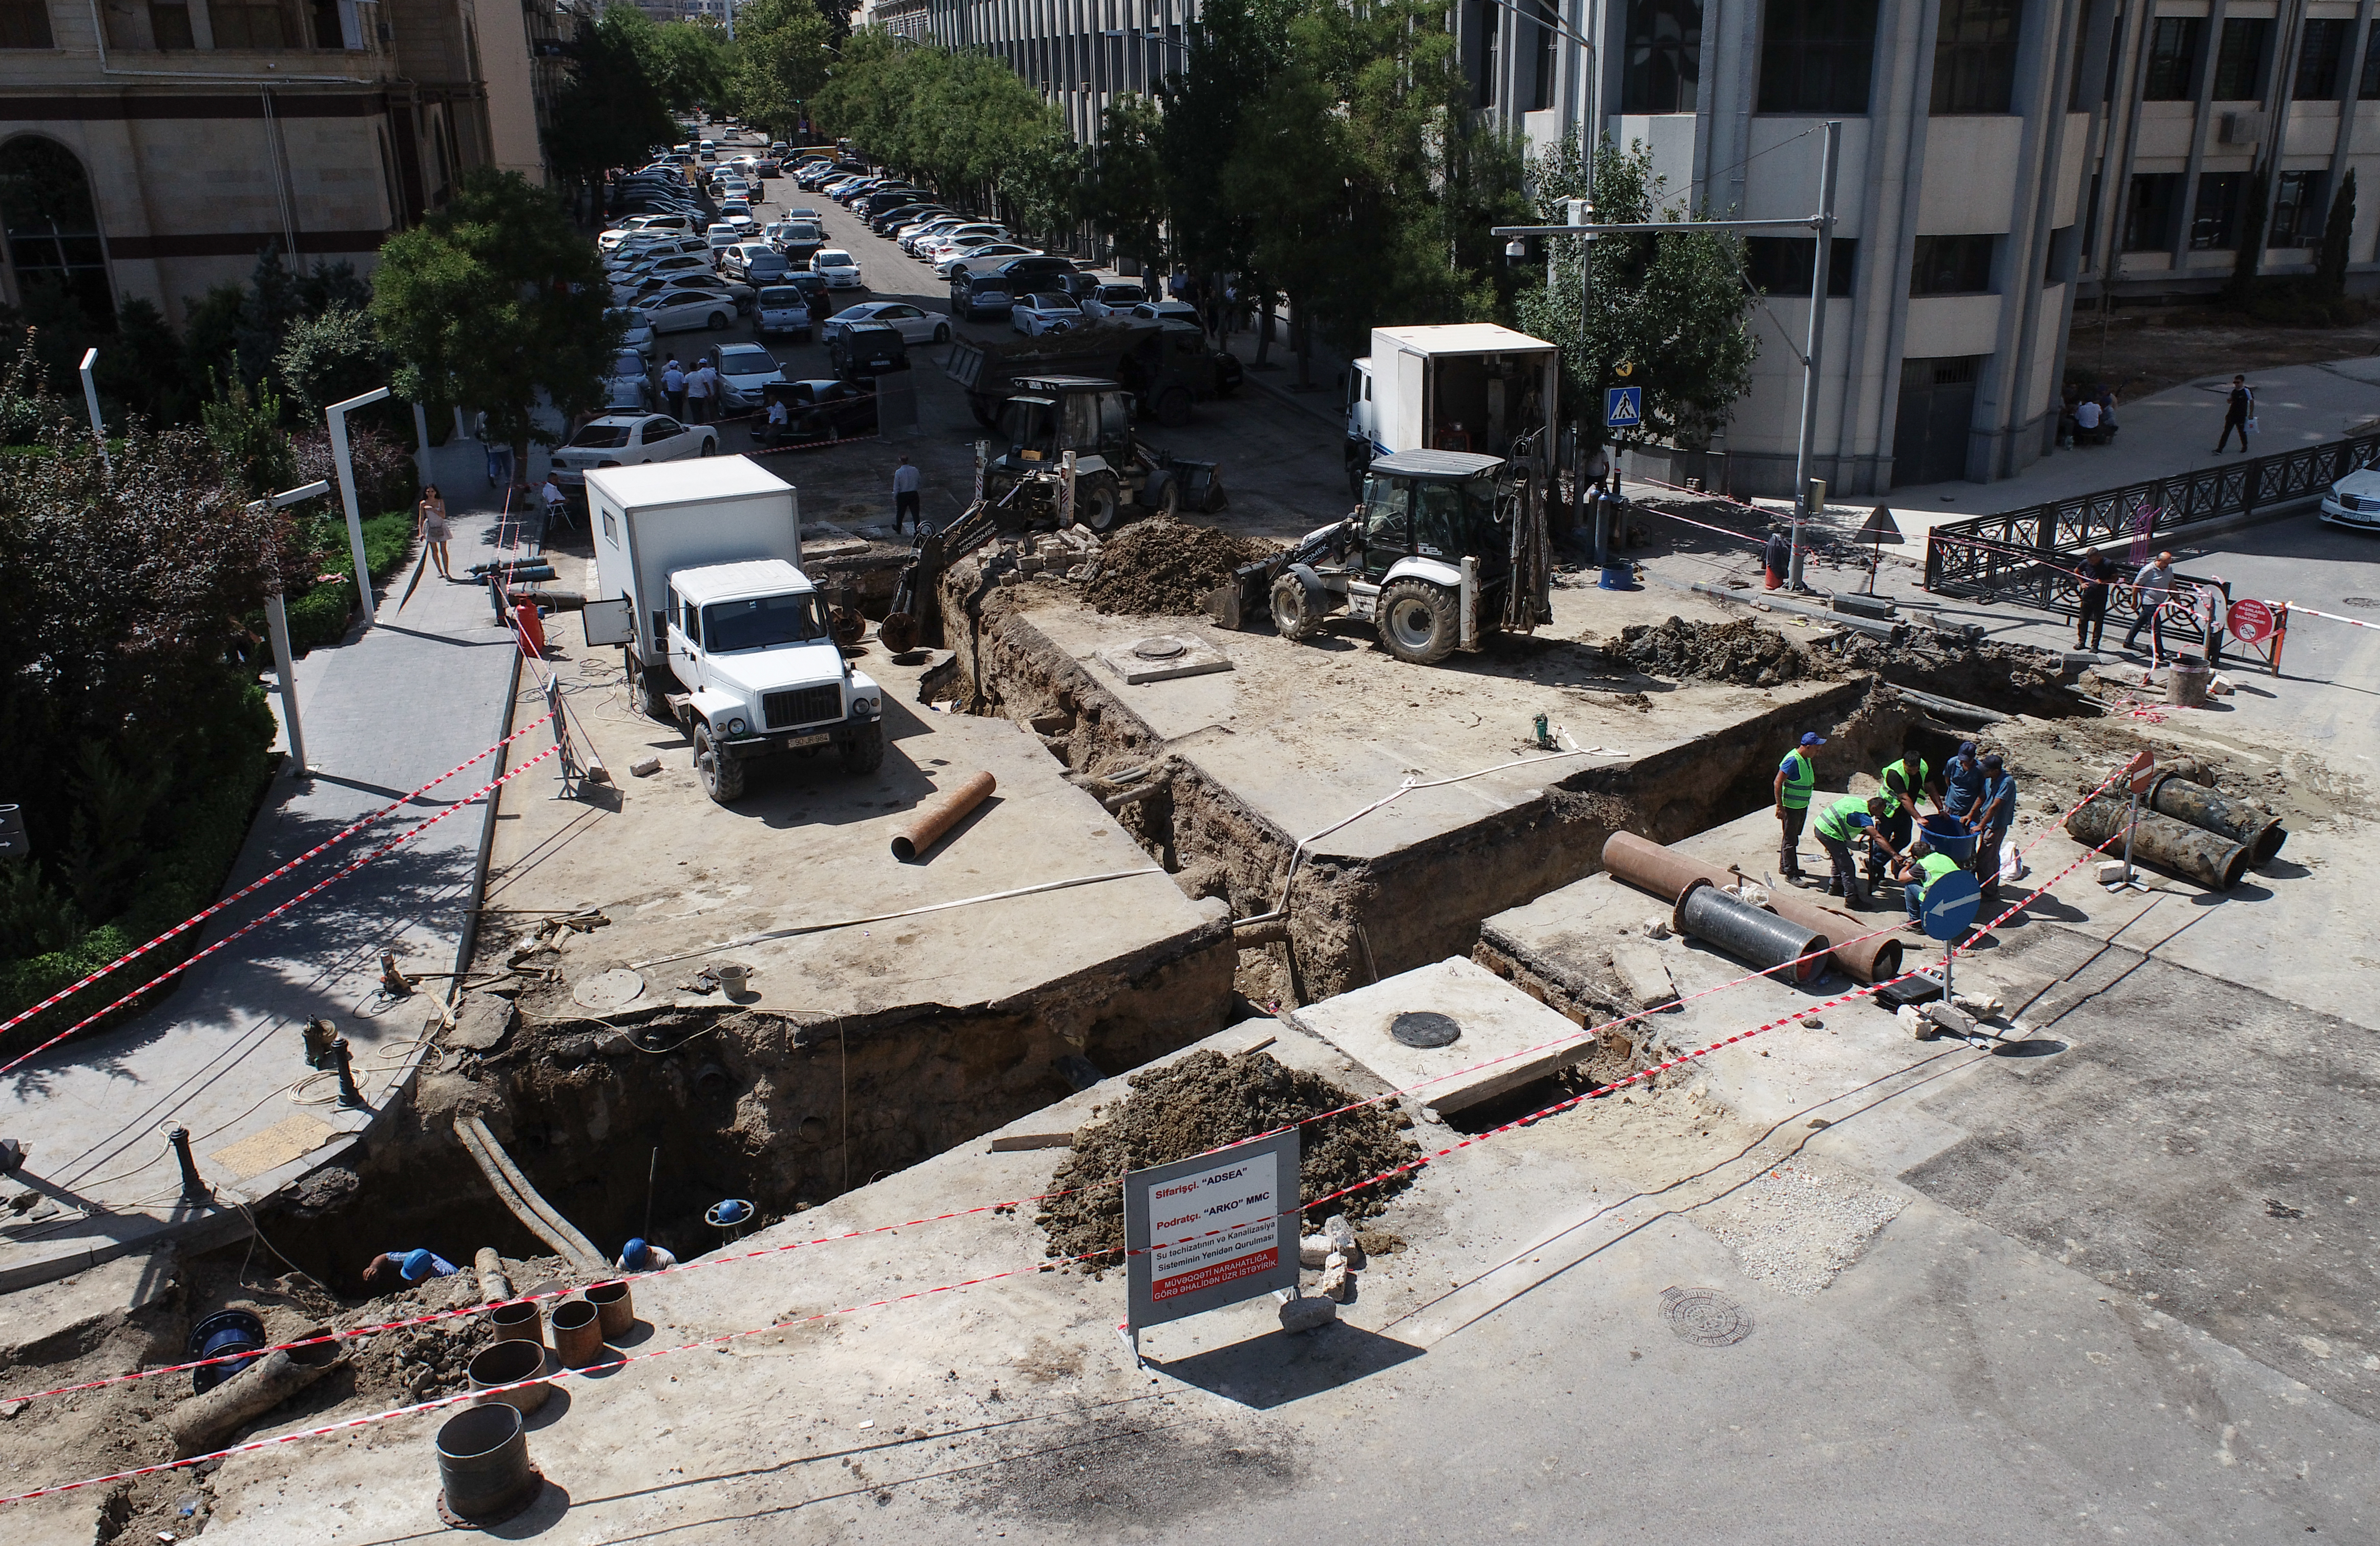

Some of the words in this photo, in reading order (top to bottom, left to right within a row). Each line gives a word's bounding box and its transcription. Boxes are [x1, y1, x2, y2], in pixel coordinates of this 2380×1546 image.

[1155, 1181, 1199, 1199] Sifarişçi.
[1246, 1192, 1270, 1205] MMC
[1158, 1256, 1200, 1272] Sisteminin
[1202, 1245, 1233, 1259] Yenidən
[1235, 1234, 1274, 1250] Qurulması
[1170, 1239, 1215, 1257] təchizatının
[1217, 1235, 1226, 1243] və
[1228, 1221, 1275, 1240] Kanalizasiya
[1154, 1287, 1178, 1300] GÖRƏ
[1180, 1276, 1220, 1293] ƏHALİDƏN
[1222, 1269, 1238, 1281] ÜZR
[1164, 1269, 1212, 1288] MÜVƏQQƏTİ
[1214, 1253, 1268, 1275] NARAHATLIĞA
